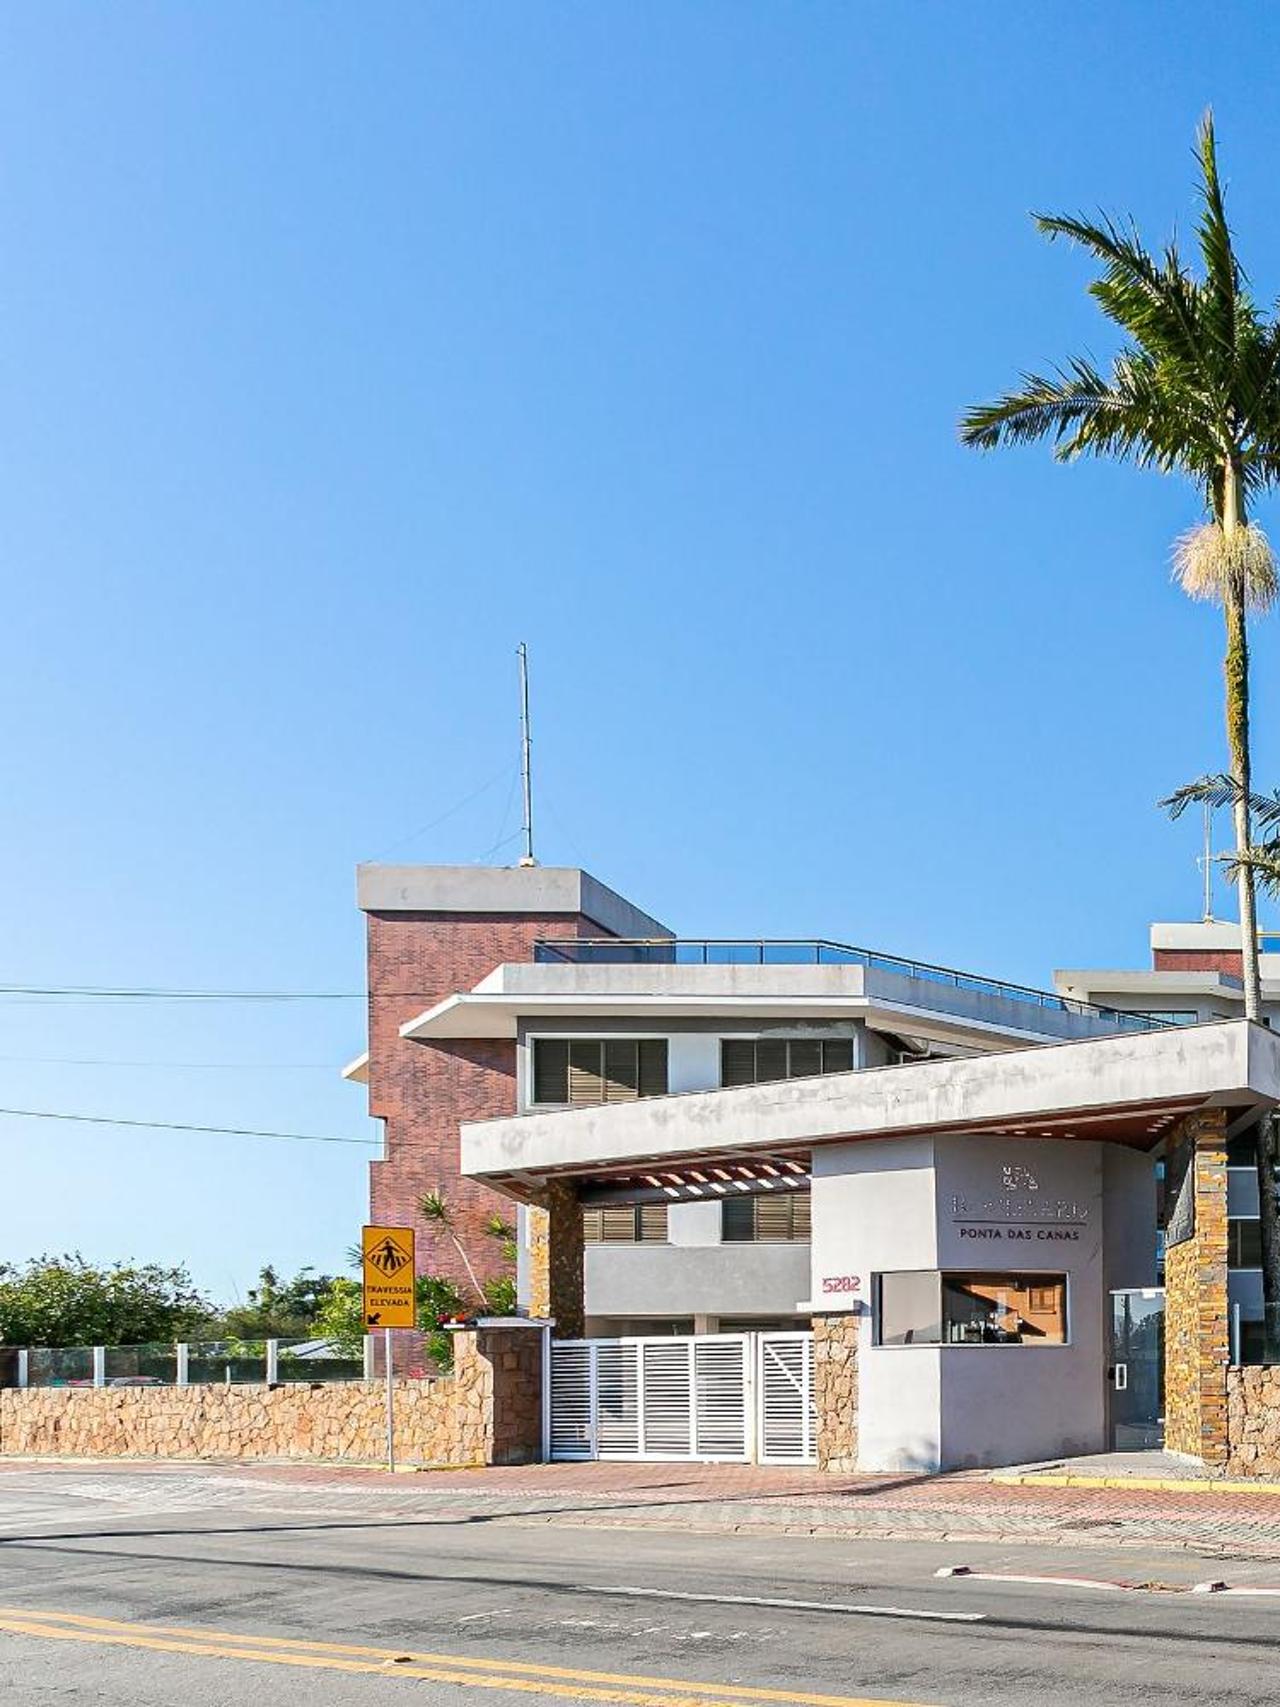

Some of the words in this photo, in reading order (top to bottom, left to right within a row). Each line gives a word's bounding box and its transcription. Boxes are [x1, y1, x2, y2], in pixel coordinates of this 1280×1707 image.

[960, 1228, 1002, 1239] PONTA
[1008, 1229, 1032, 1240] DAS
[1037, 1230, 1079, 1240] CANAS
[367, 1285, 412, 1295] TRAVESSIA
[822, 1276, 861, 1293] 5282
[370, 1298, 409, 1307] ELEVADA
